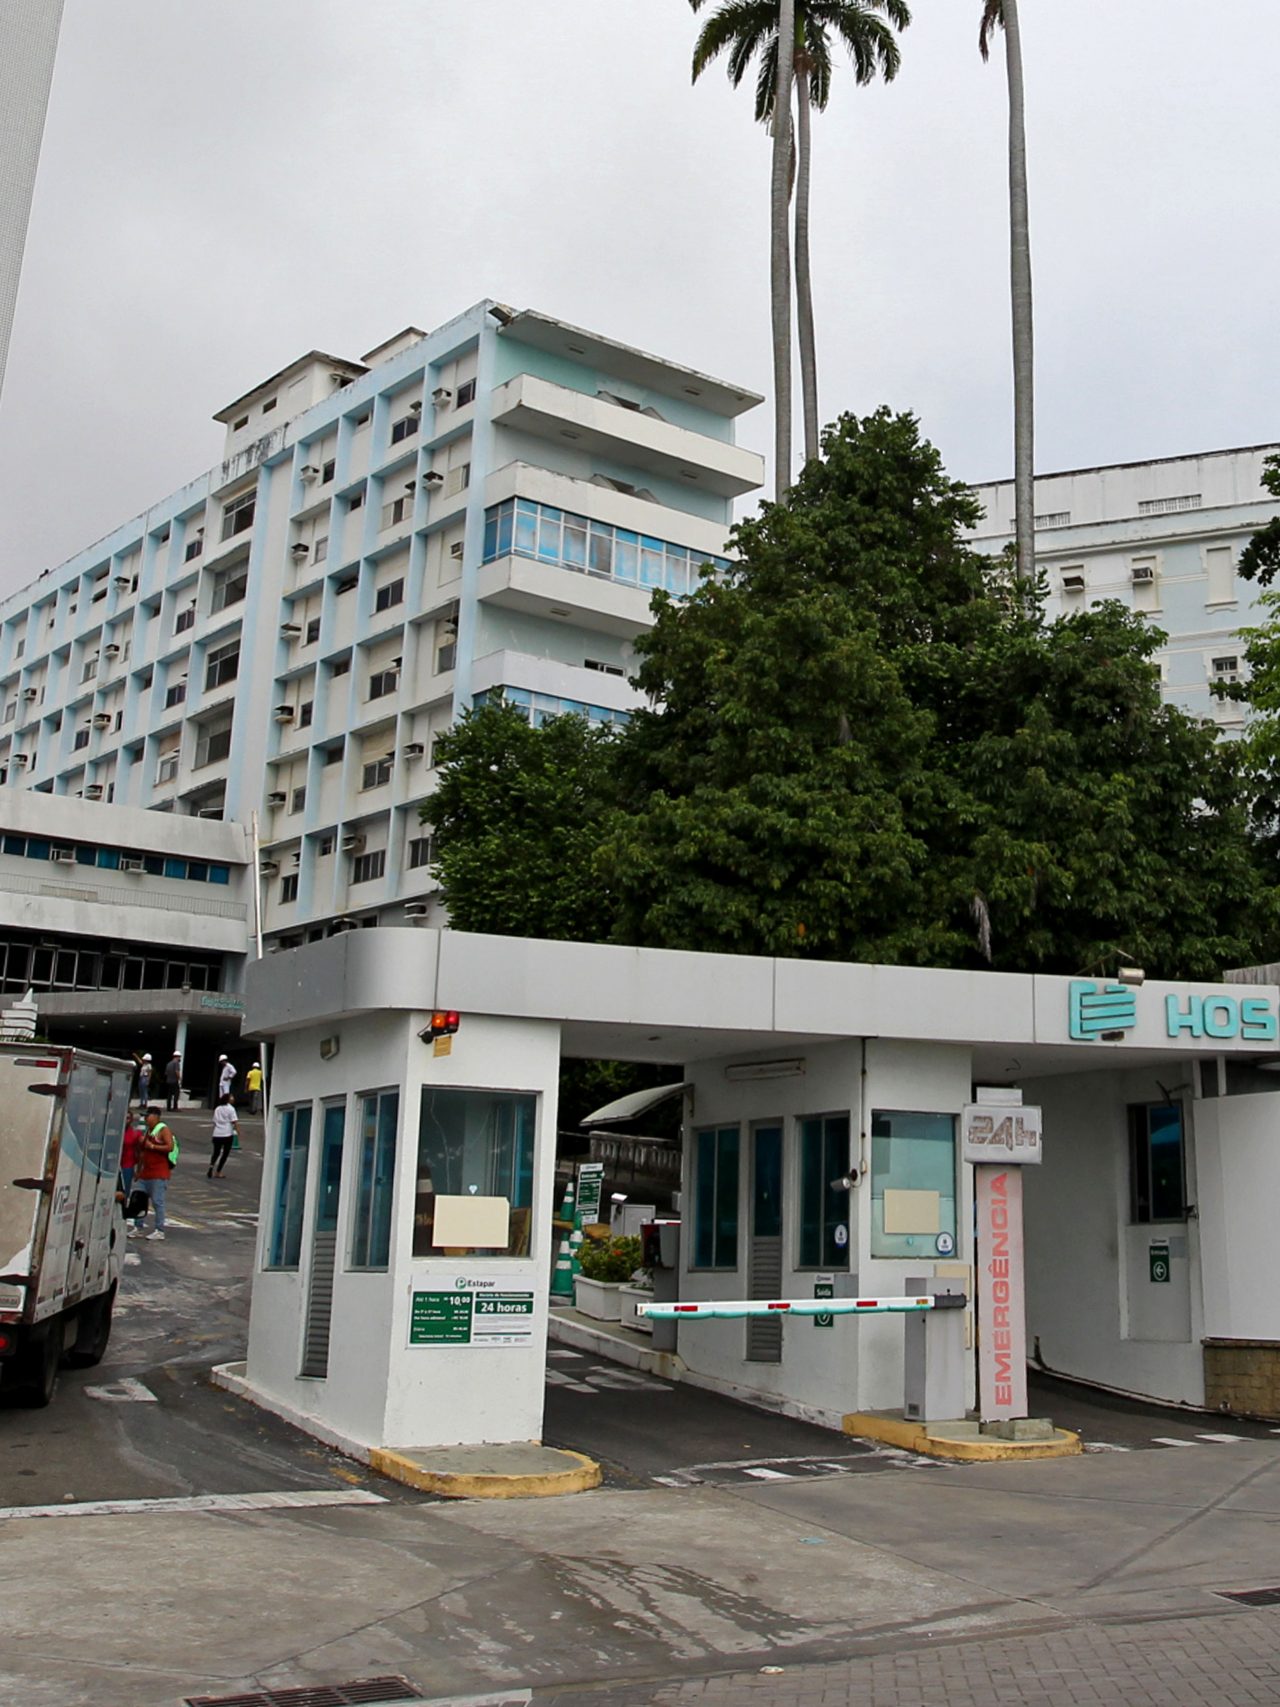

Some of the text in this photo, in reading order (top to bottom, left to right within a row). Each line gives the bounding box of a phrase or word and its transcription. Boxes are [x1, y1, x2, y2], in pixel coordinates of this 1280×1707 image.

[967, 1114, 1038, 1152] 24h
[467, 1280, 496, 1288] Estapar
[988, 1172, 1013, 1407] EMERGÊNCIA
[481, 1302, 528, 1313] 24 horas
